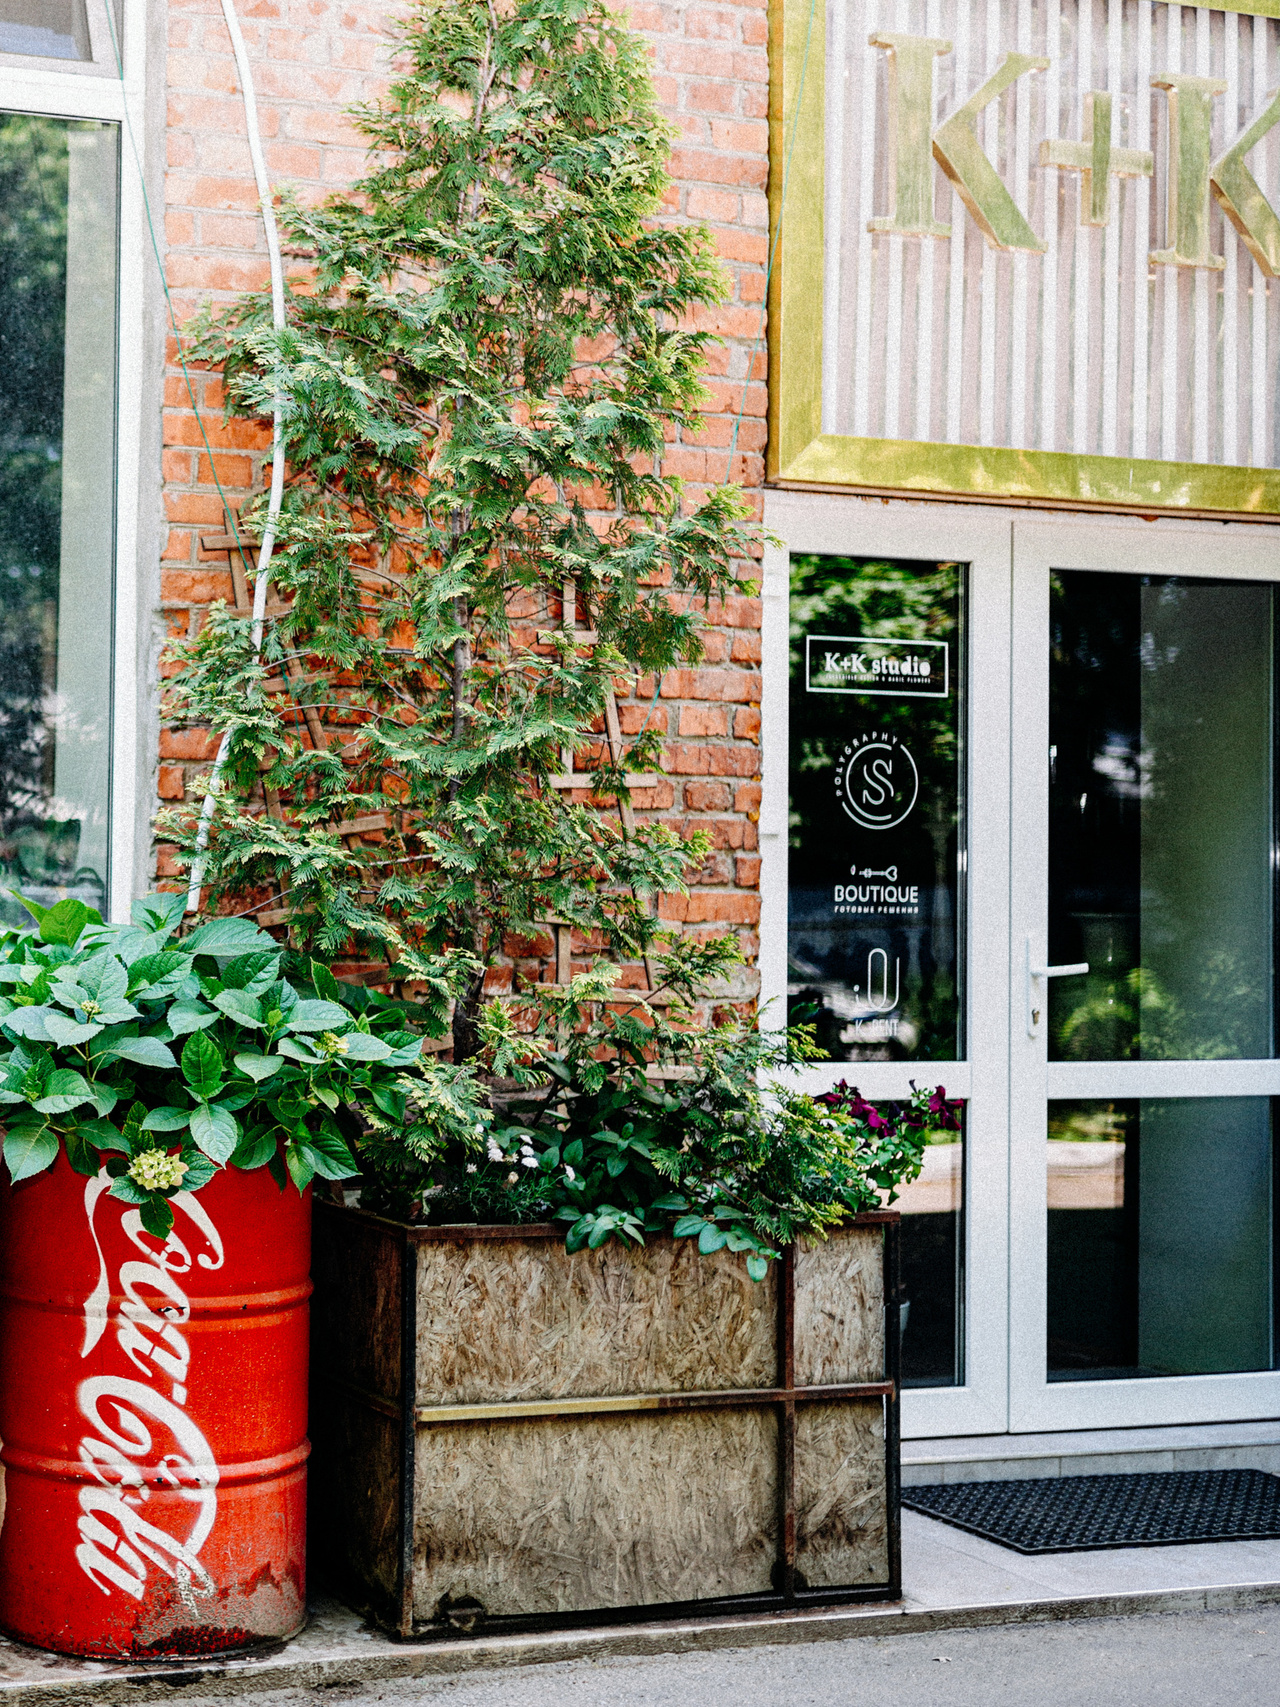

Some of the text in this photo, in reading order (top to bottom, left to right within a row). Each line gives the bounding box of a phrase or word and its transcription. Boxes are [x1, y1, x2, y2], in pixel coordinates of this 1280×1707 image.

[824, 652, 931, 677] K+K studio
[834, 730, 898, 797] POLYGRAPHY
[834, 884, 919, 904] BOUTIQUE
